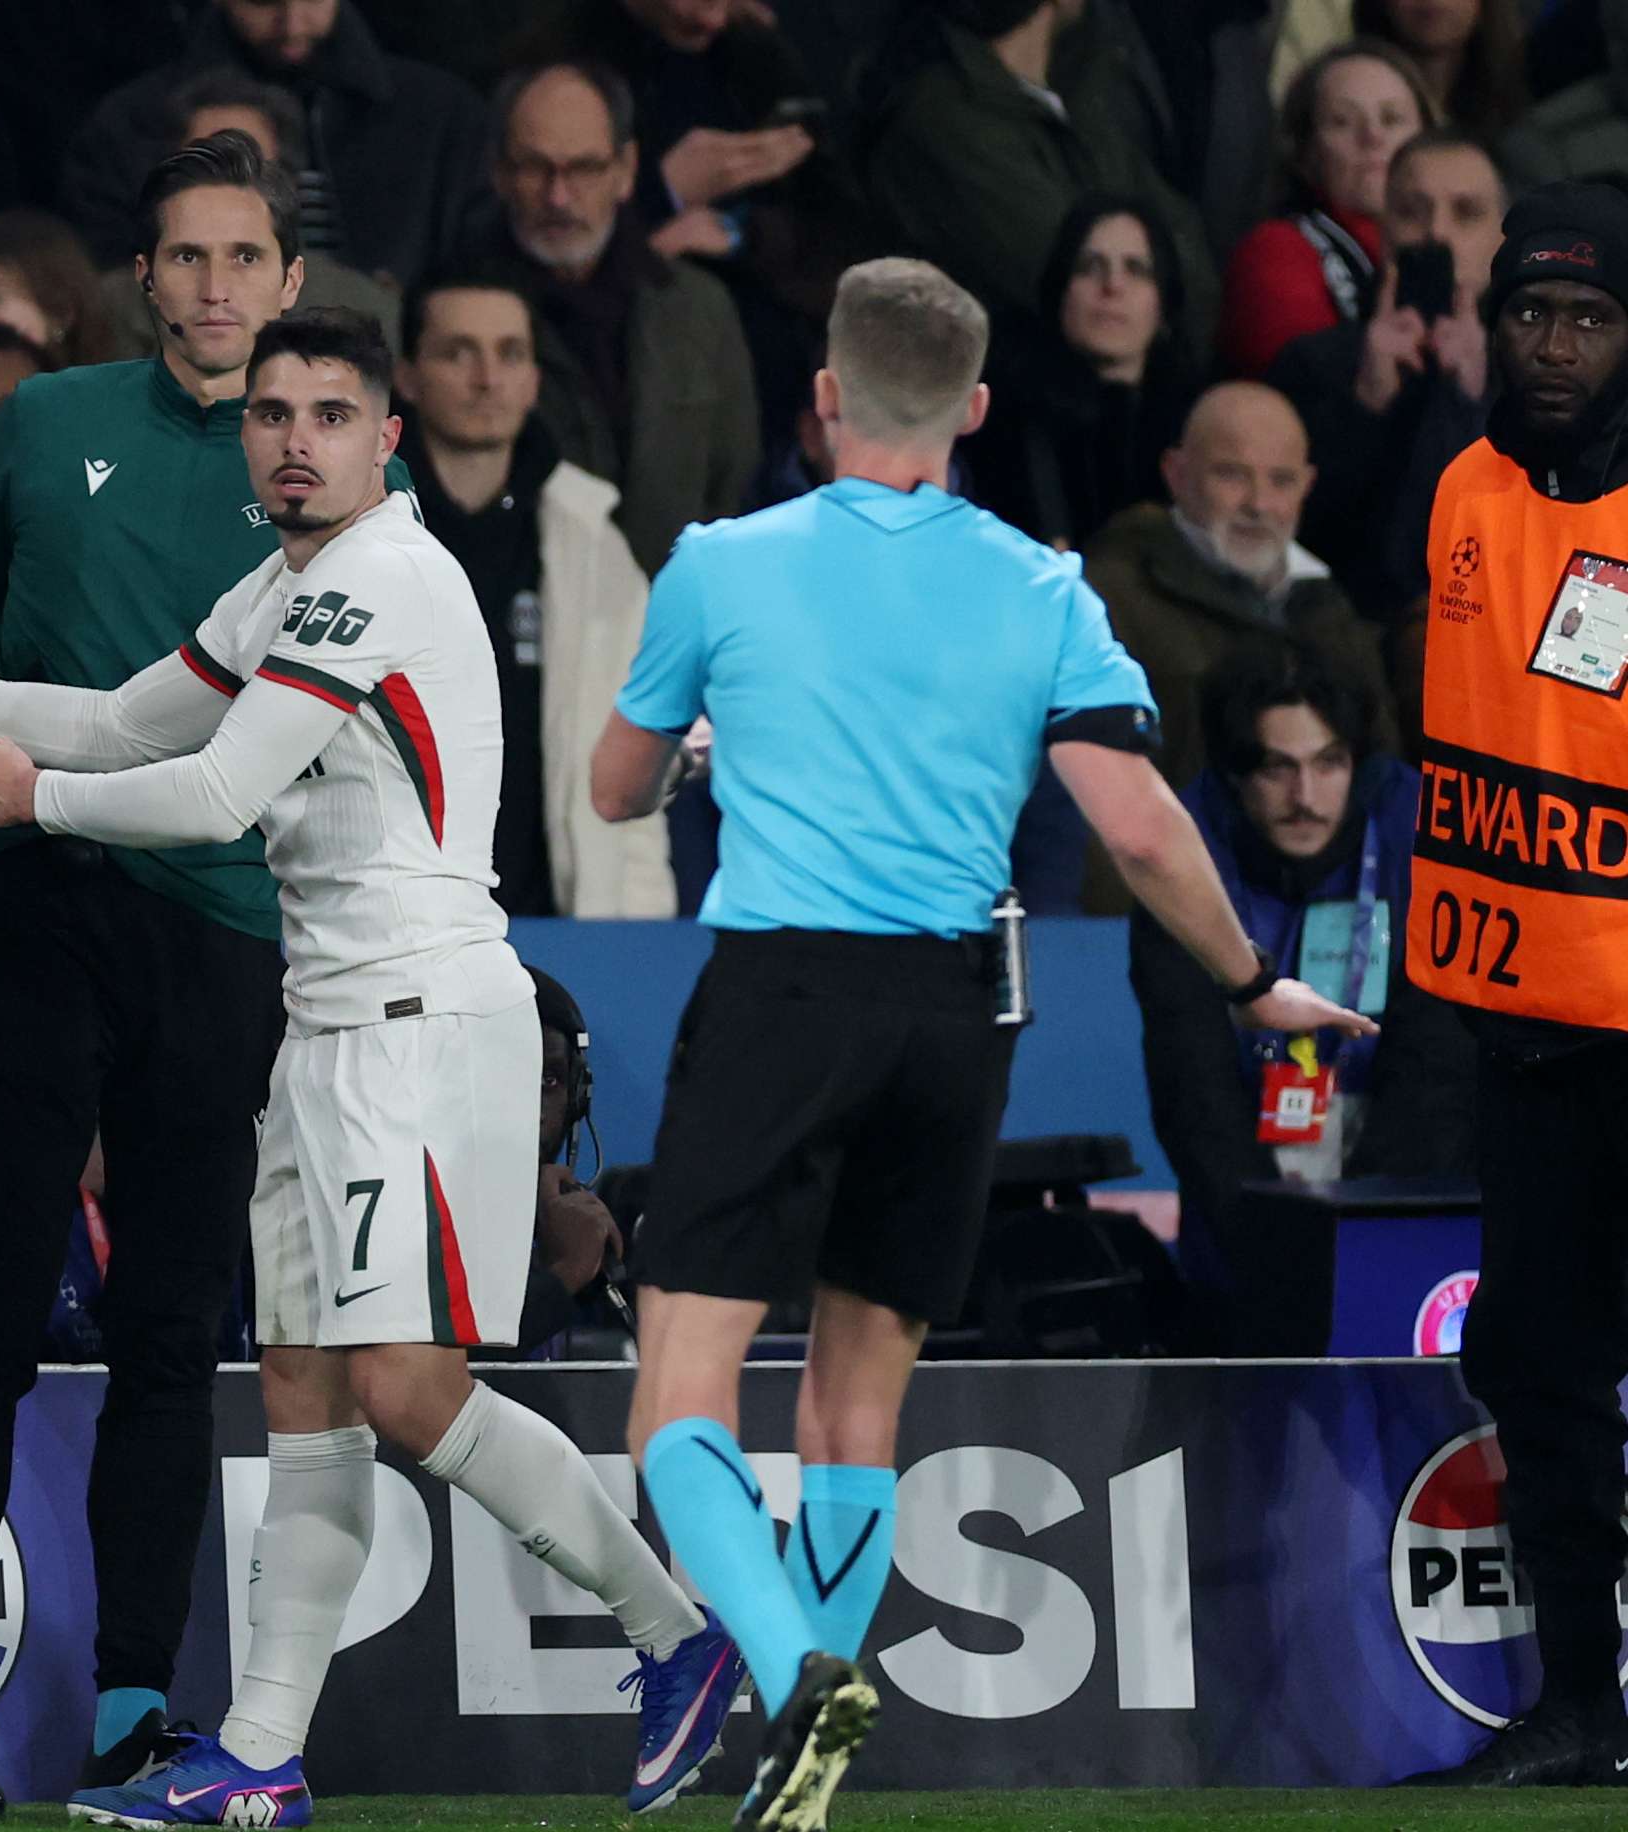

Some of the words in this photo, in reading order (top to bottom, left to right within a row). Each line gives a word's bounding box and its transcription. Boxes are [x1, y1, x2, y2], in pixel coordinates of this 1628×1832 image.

[284, 597, 370, 641] FPT
[1430, 891, 1521, 988] 072
[345, 1178, 385, 1272] 7
[221, 1446, 1196, 1719] PESI
